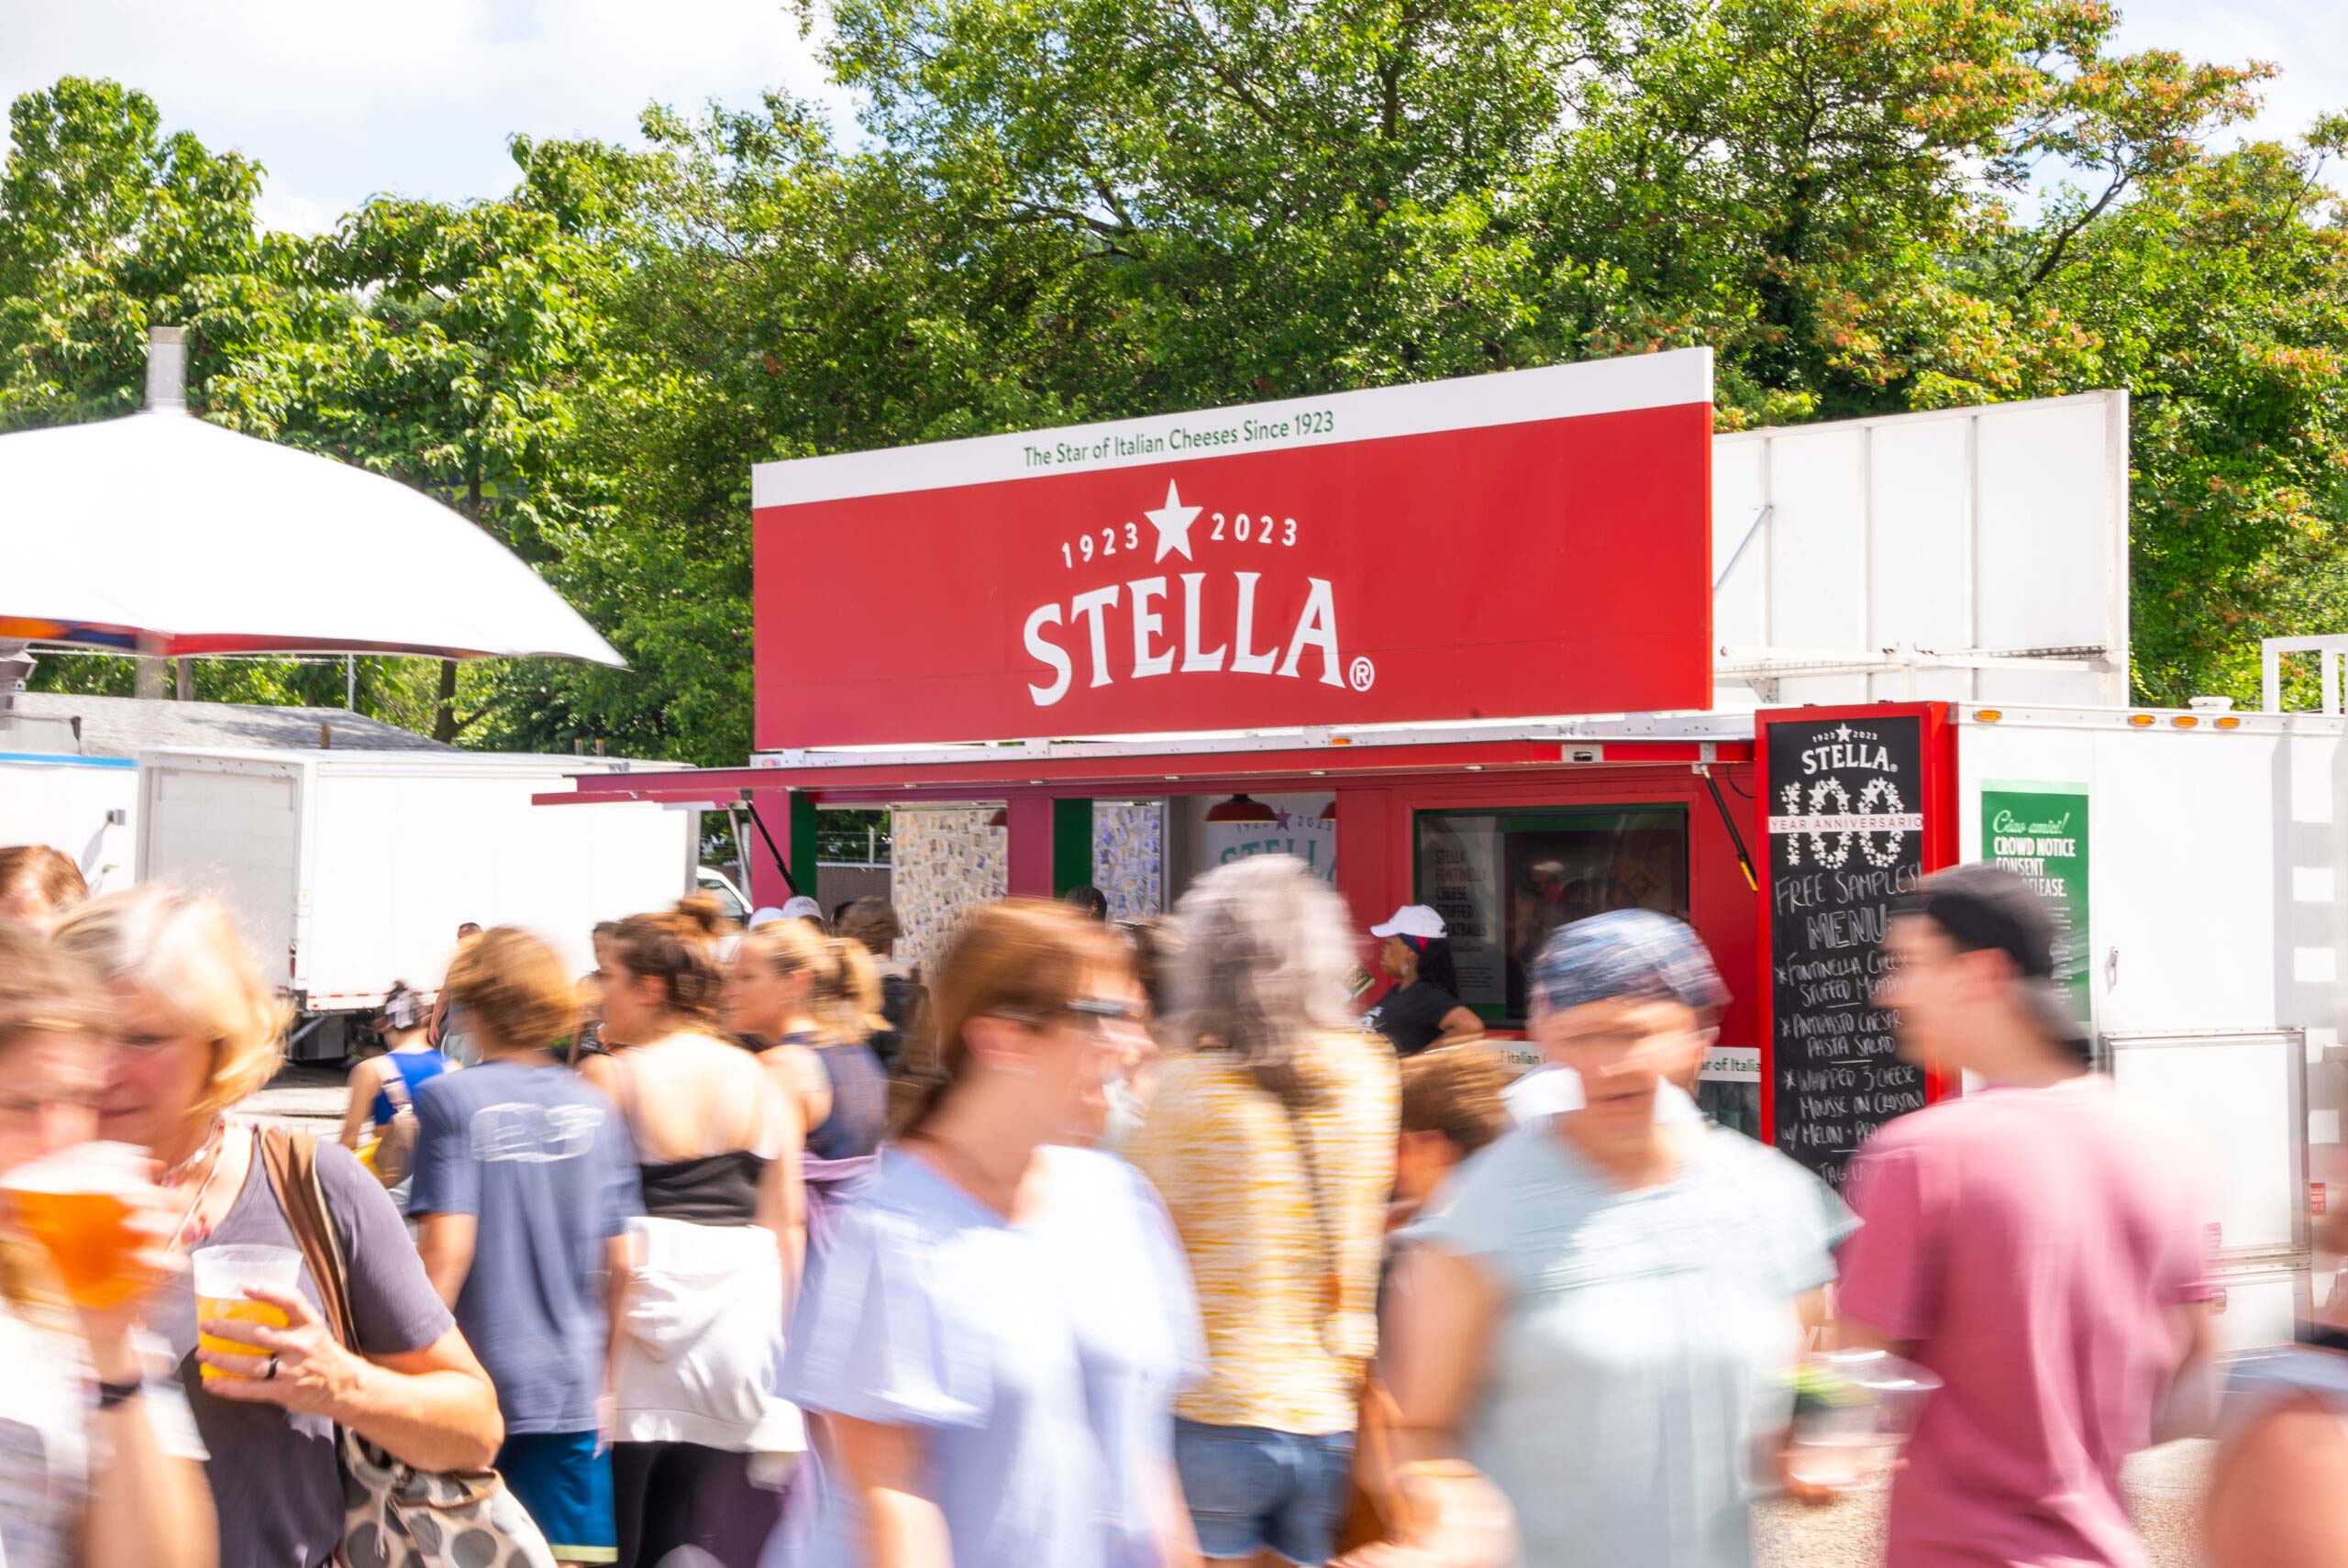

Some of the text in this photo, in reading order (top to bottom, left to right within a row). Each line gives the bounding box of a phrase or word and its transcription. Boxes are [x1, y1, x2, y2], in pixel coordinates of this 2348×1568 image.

[1024, 411, 1335, 468] The Star of Italian Cheeses Since 1923
[1061, 513, 1297, 569] 1923 2023
[1812, 730, 1877, 743] 1923 2023
[1771, 820, 1807, 830] YEAR
[1993, 810, 2026, 834] Ciao
[1994, 836, 2077, 857] CROWD NOTICE
[1996, 857, 2045, 877] CONSENT
[1775, 873, 1826, 916] FREE
[1800, 978, 1851, 1008] STUFFED
[1858, 1010, 1903, 1033] CAESAR
[1507, 1050, 1541, 1065] Italian
[1807, 1035, 1896, 1058] PASTA SALAD
[1714, 1056, 1727, 1071] of
[1854, 1096, 1871, 1114] ON
[1802, 1123, 1844, 1146] MELON
